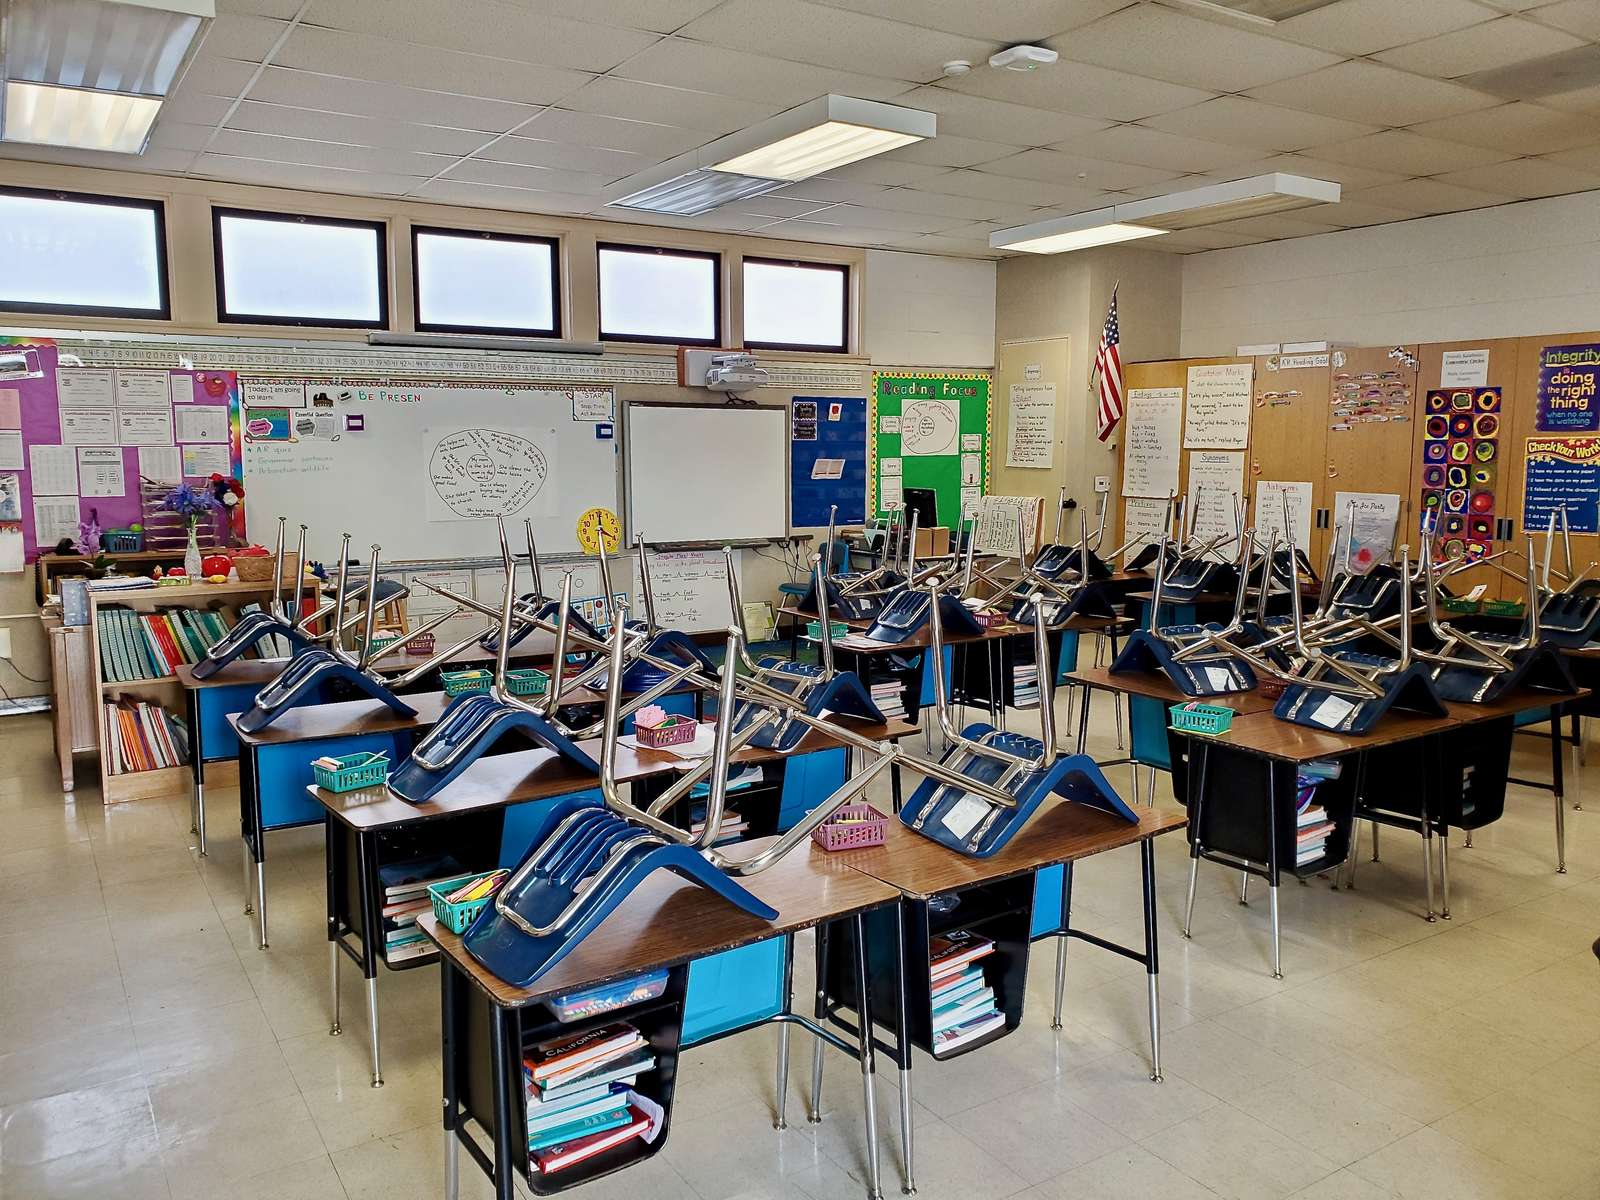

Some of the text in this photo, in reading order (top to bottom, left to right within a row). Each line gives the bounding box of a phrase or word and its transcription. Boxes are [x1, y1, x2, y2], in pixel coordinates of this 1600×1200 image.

[1546, 348, 1600, 365] Integrity
[1551, 372, 1595, 386] doing
[883, 381, 978, 399] Reading Focus
[1548, 384, 1597, 399] the right
[1551, 396, 1589, 411] thing
[1528, 442, 1556, 453] Check
[1555, 443, 1576, 457] Your
[1369, 502, 1385, 512] Party
[545, 1029, 608, 1057] CALIFORNIA
